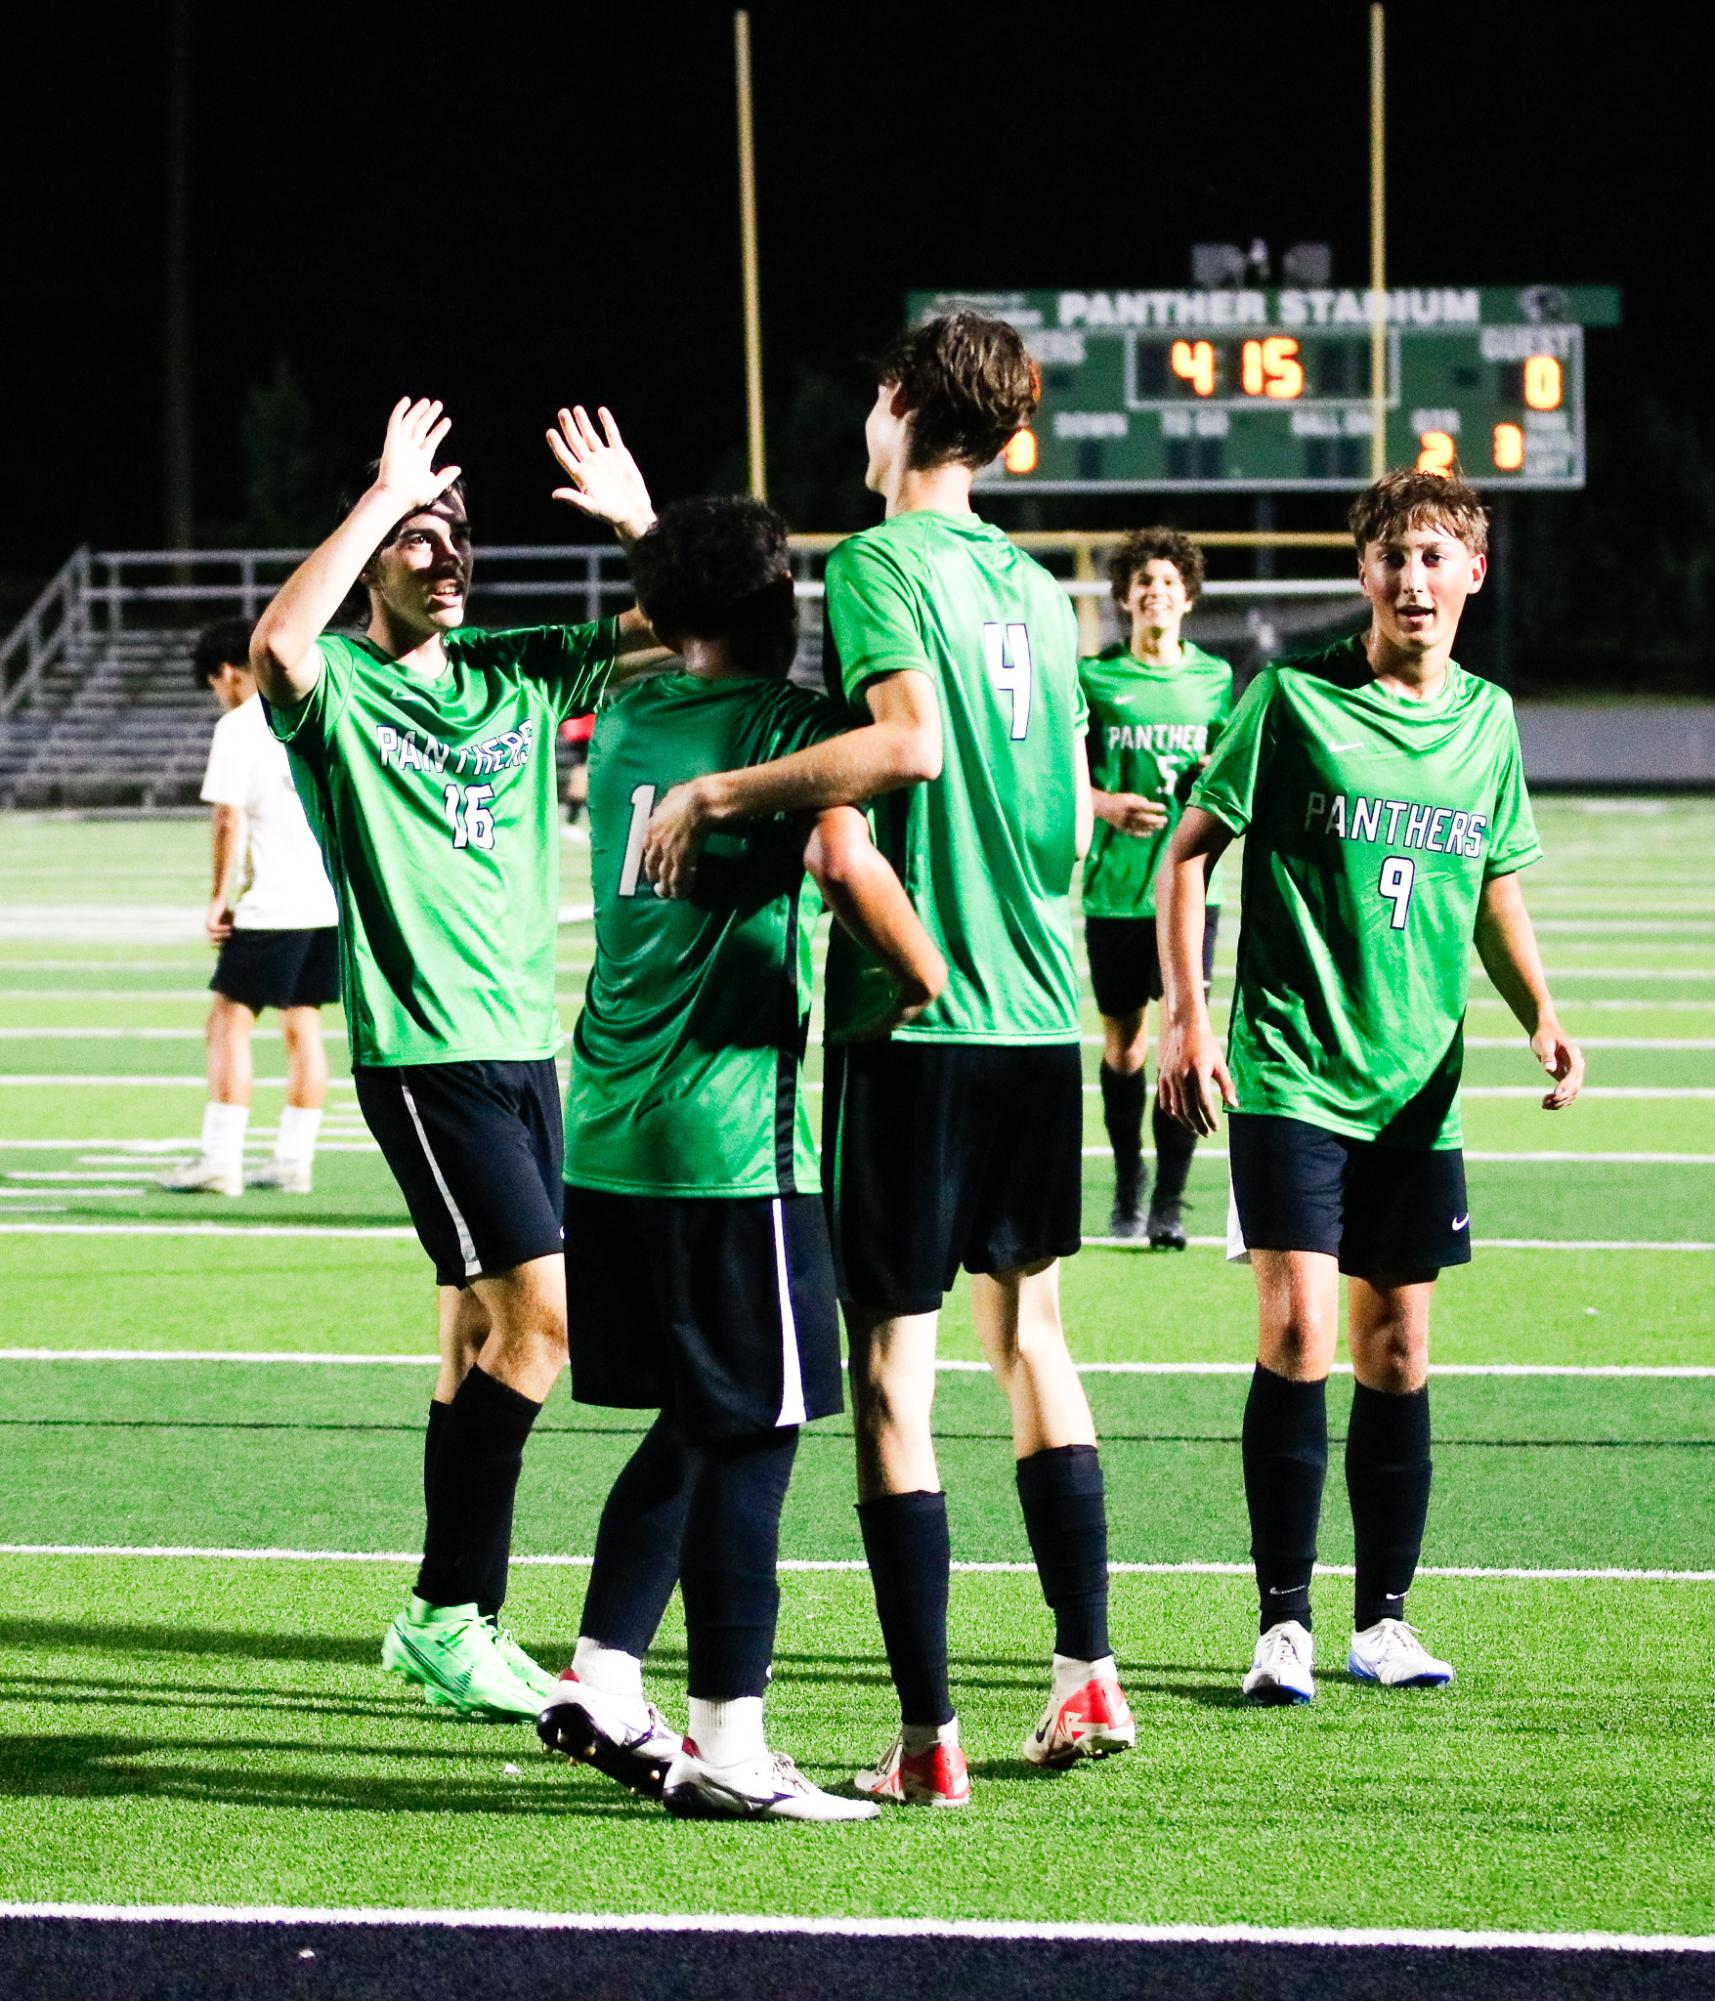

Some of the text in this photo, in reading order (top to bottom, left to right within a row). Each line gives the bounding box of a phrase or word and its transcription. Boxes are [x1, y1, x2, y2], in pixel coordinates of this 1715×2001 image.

[1058, 289, 1267, 325] PANTHER
[1171, 336, 1304, 399] 4 15
[1524, 355, 1563, 412] 0
[1417, 431, 1455, 479] 2
[982, 621, 1032, 741] 4
[1108, 724, 1209, 753] PANTHER
[443, 783, 496, 850] 16
[618, 784, 656, 897] 1
[1304, 791, 1488, 859] PANTHERS
[1378, 855, 1416, 931] 9
